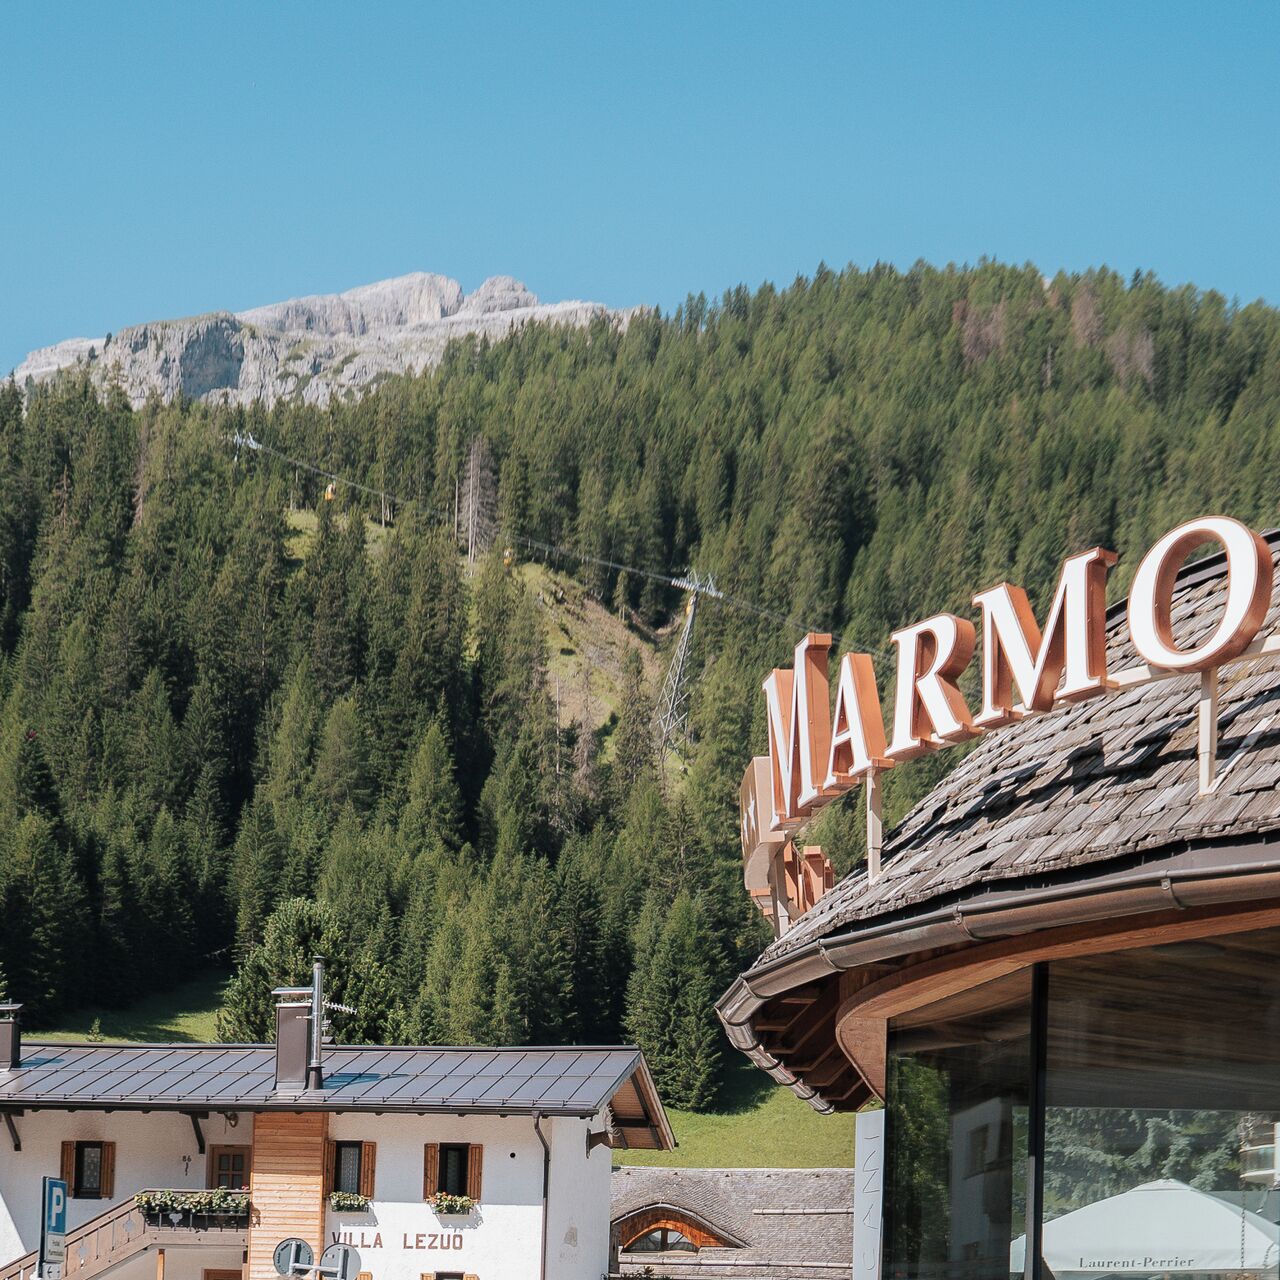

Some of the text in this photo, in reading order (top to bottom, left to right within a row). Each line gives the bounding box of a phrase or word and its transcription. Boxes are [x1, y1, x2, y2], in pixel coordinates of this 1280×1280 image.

[51, 1187, 64, 1227] P
[332, 1232, 463, 1250] VILLA LEZUO
[1080, 1256, 1195, 1269] Laurent-Perrier
